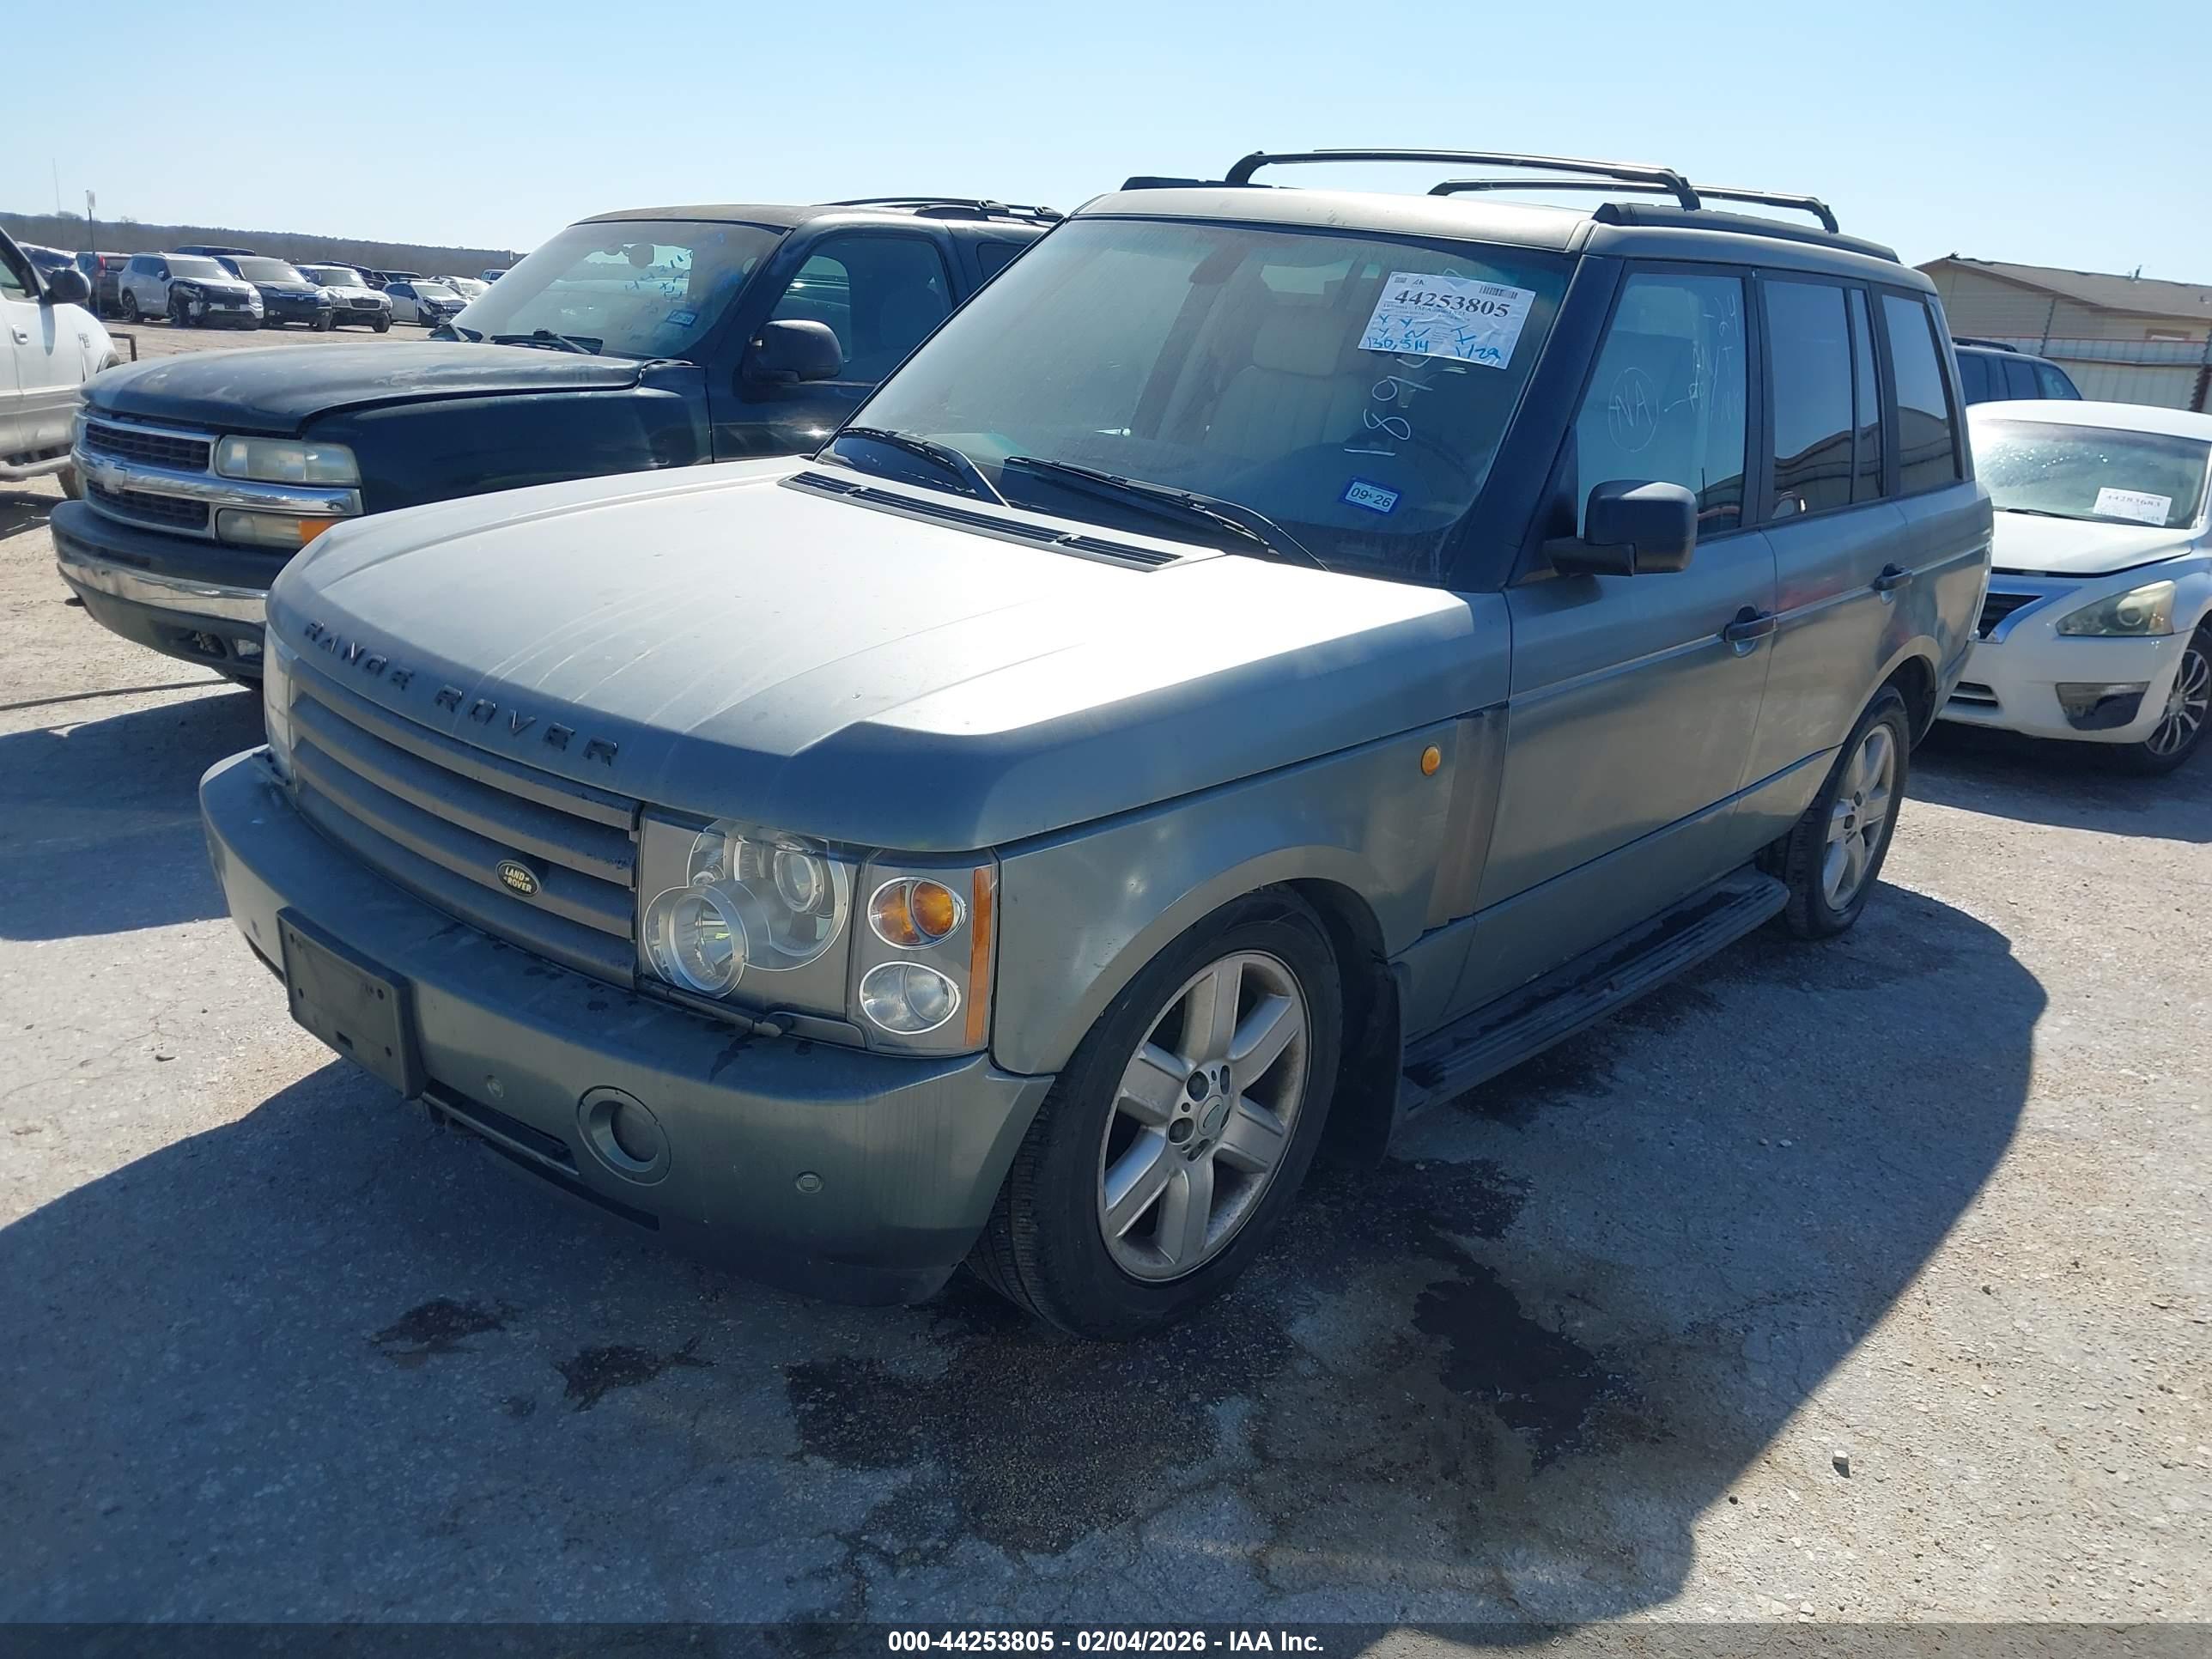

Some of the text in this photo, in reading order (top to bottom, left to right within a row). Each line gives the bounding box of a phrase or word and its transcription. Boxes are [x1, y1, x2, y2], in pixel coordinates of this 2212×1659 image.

[1395, 290, 1510, 317] 44253805
[304, 619, 619, 767] RANGE ROVER
[505, 866, 526, 881] LAND
[507, 877, 532, 893] ROVER
